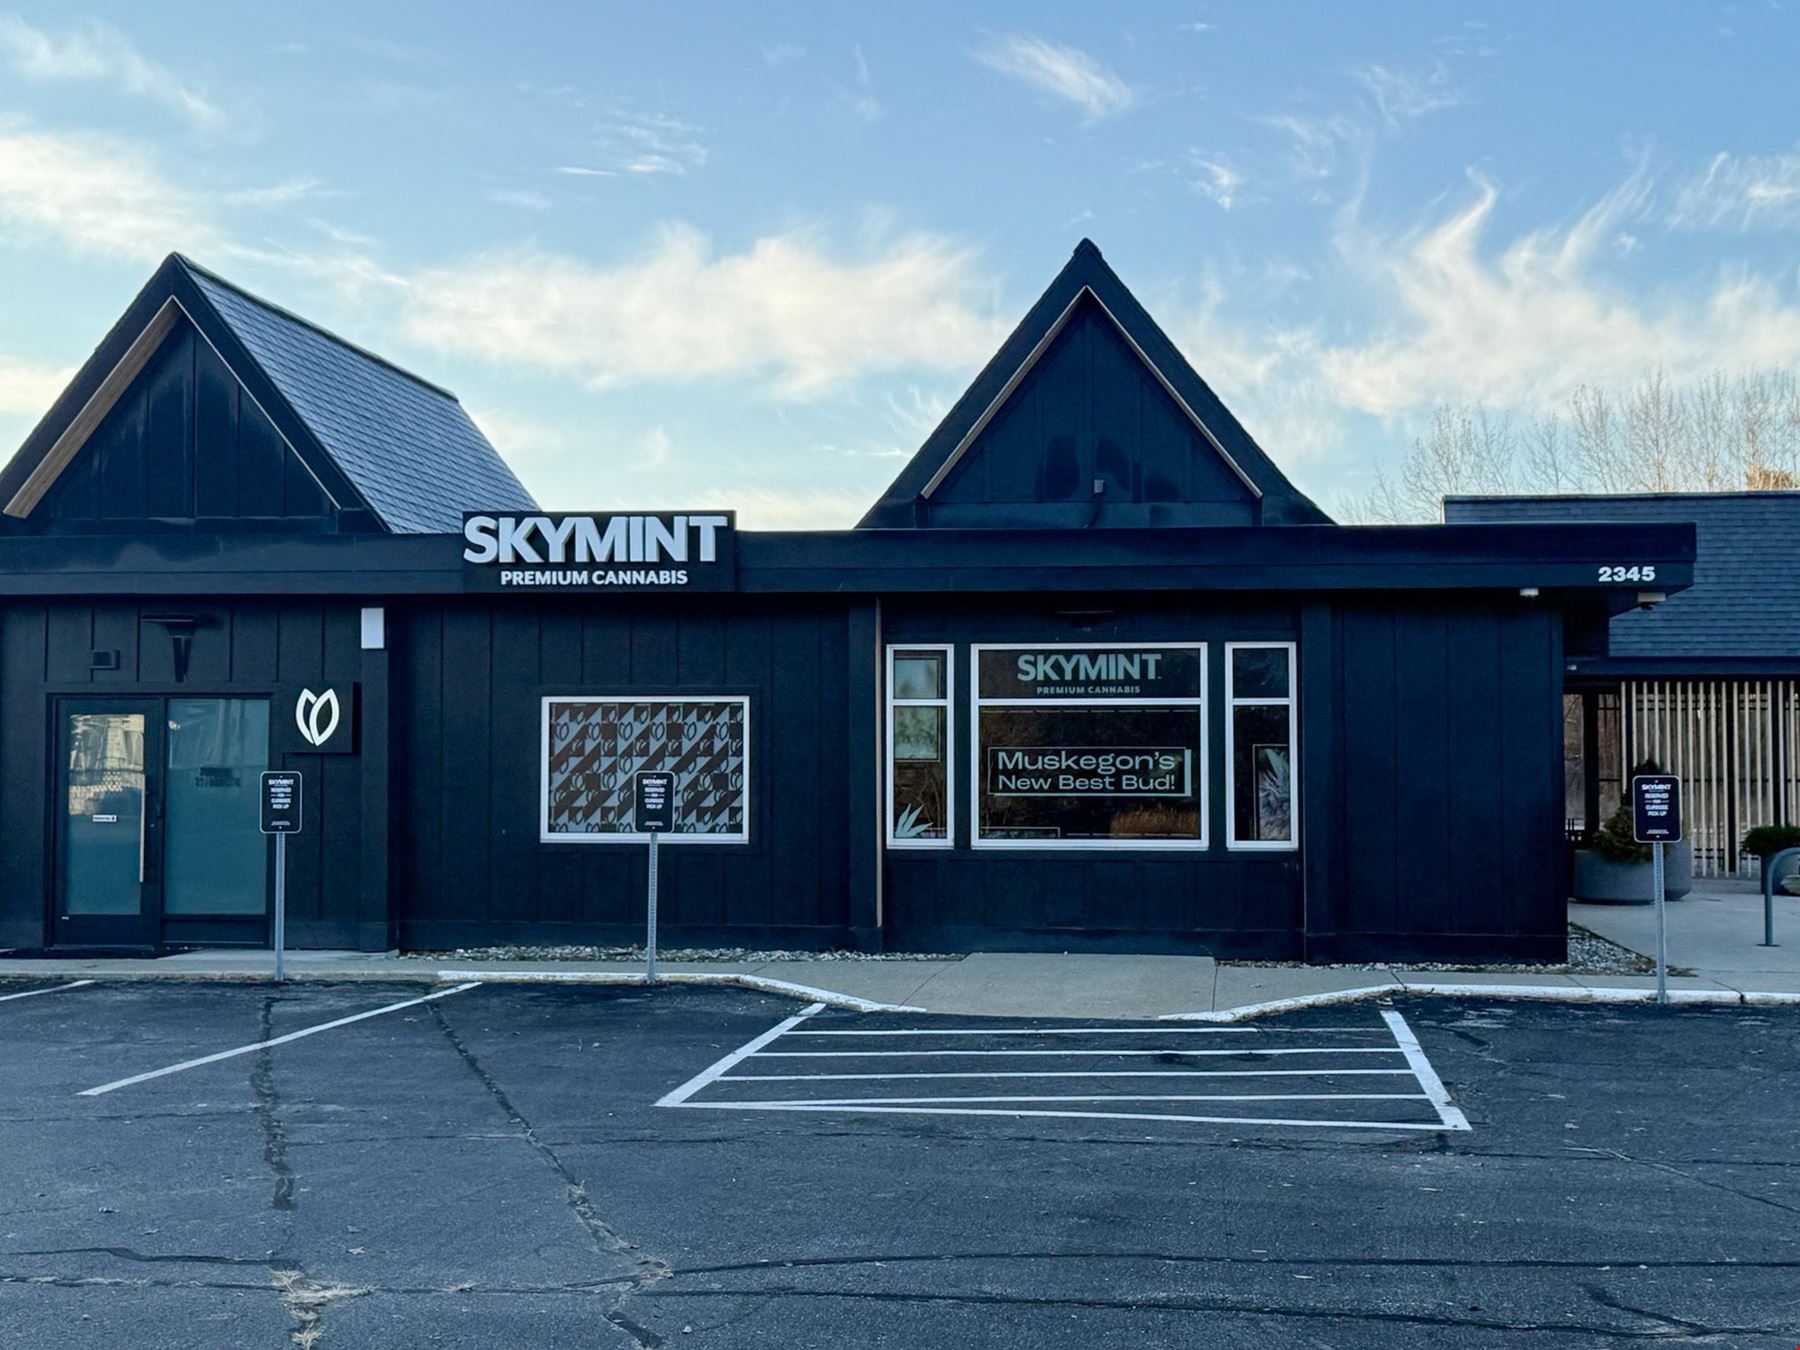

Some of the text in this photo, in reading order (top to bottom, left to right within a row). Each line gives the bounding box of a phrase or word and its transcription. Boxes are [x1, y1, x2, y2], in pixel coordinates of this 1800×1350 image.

[463, 515, 728, 564] SKYMINT
[501, 569, 689, 586] PREMIUM CANNABIS
[1598, 565, 1656, 582] 2345
[1017, 653, 1162, 681] SKYMINT
[1036, 685, 1141, 695] PREMIUM CANNABIS
[998, 750, 1176, 775] Muskegon's
[998, 774, 1175, 790] New Best Bud!
